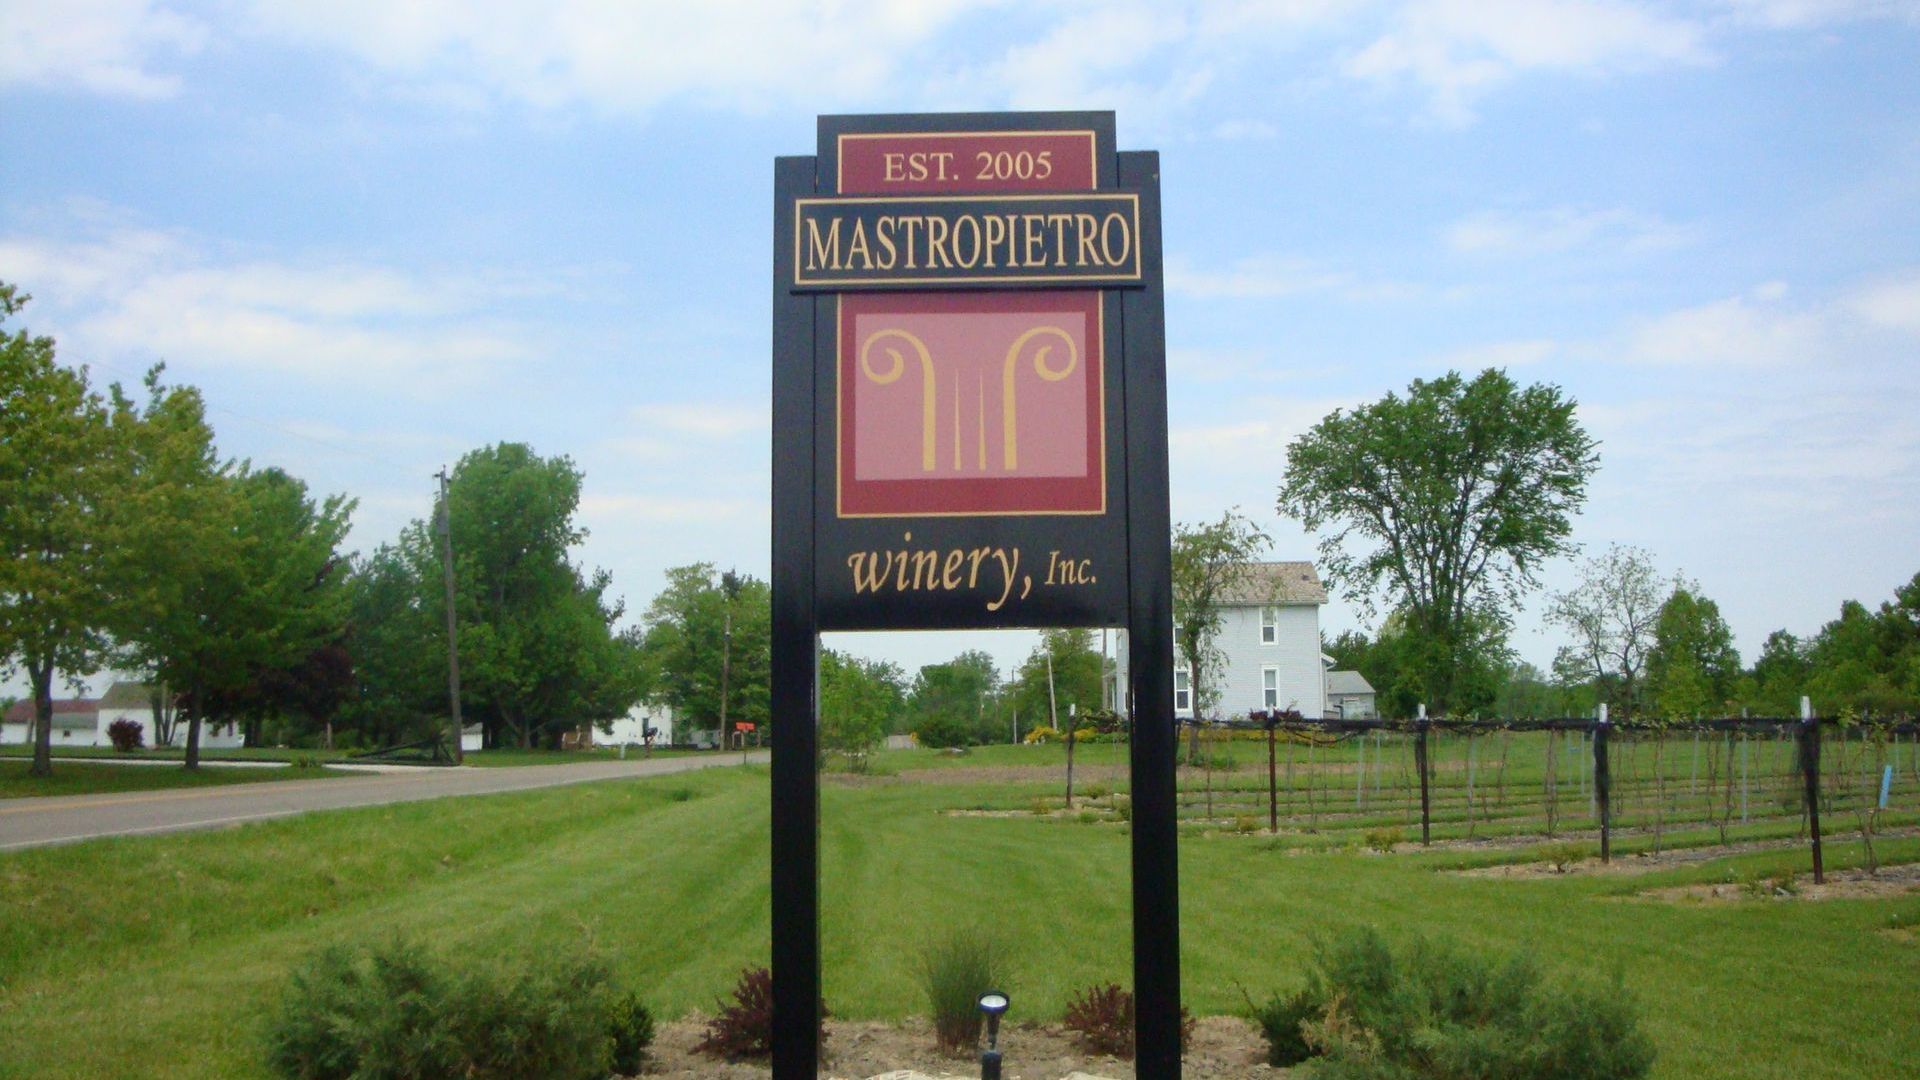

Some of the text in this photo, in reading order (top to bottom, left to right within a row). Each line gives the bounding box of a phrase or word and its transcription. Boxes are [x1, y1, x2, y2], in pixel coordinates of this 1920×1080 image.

[883, 151, 1053, 182] EST. 2005
[806, 213, 1131, 270] MASTROPIETRO
[847, 532, 1097, 611] winery, Inc.
